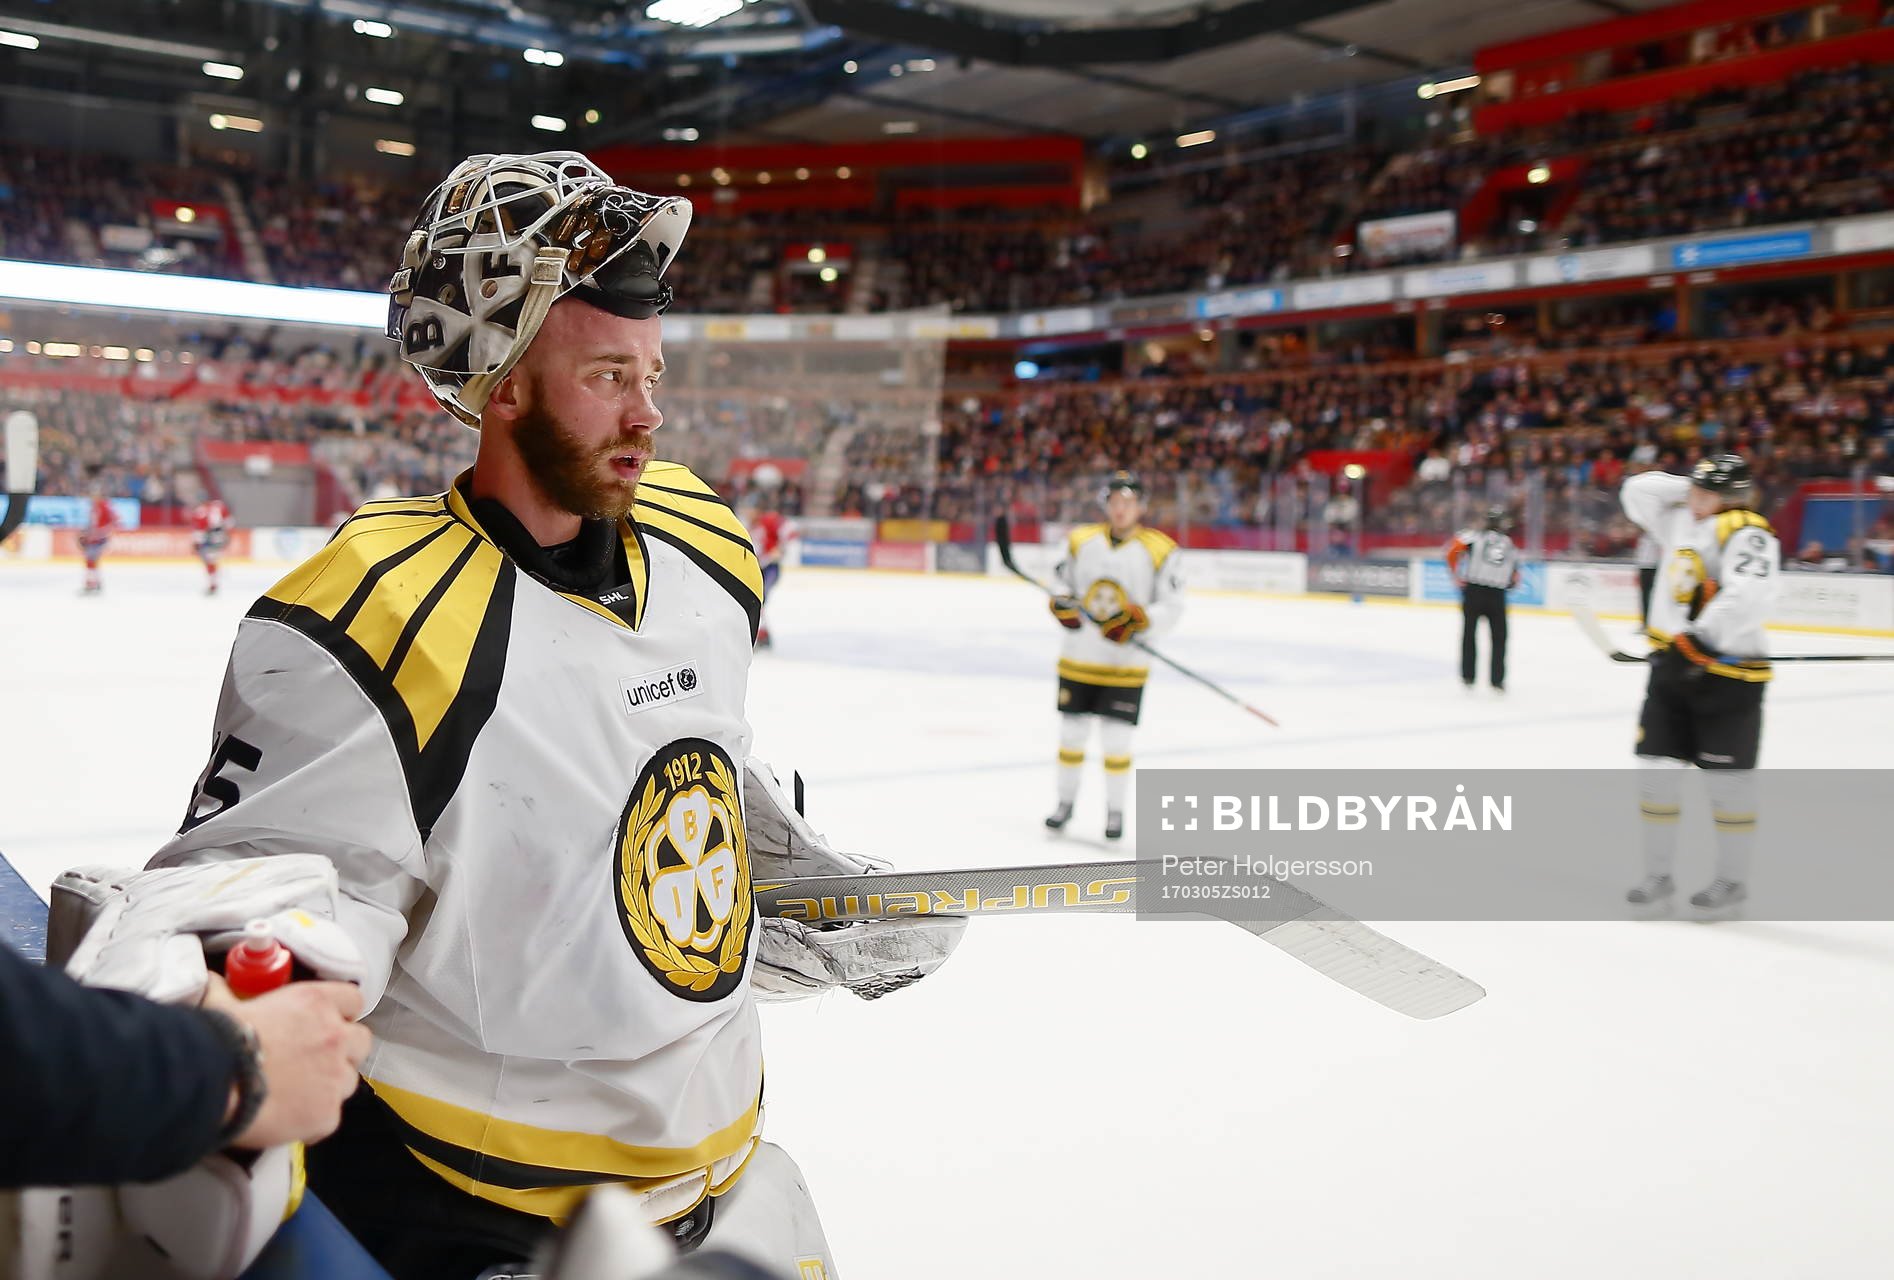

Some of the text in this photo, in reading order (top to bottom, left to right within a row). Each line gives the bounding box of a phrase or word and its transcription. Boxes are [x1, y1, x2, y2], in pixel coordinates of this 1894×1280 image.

[406, 313, 446, 355] B
[1733, 552, 1771, 578] 23
[599, 591, 629, 605] SHL
[626, 672, 676, 706] unicef
[177, 731, 263, 835] 5
[663, 752, 703, 791] 1912
[683, 809, 699, 842] B
[711, 864, 724, 899] F
[671, 886, 682, 918] I
